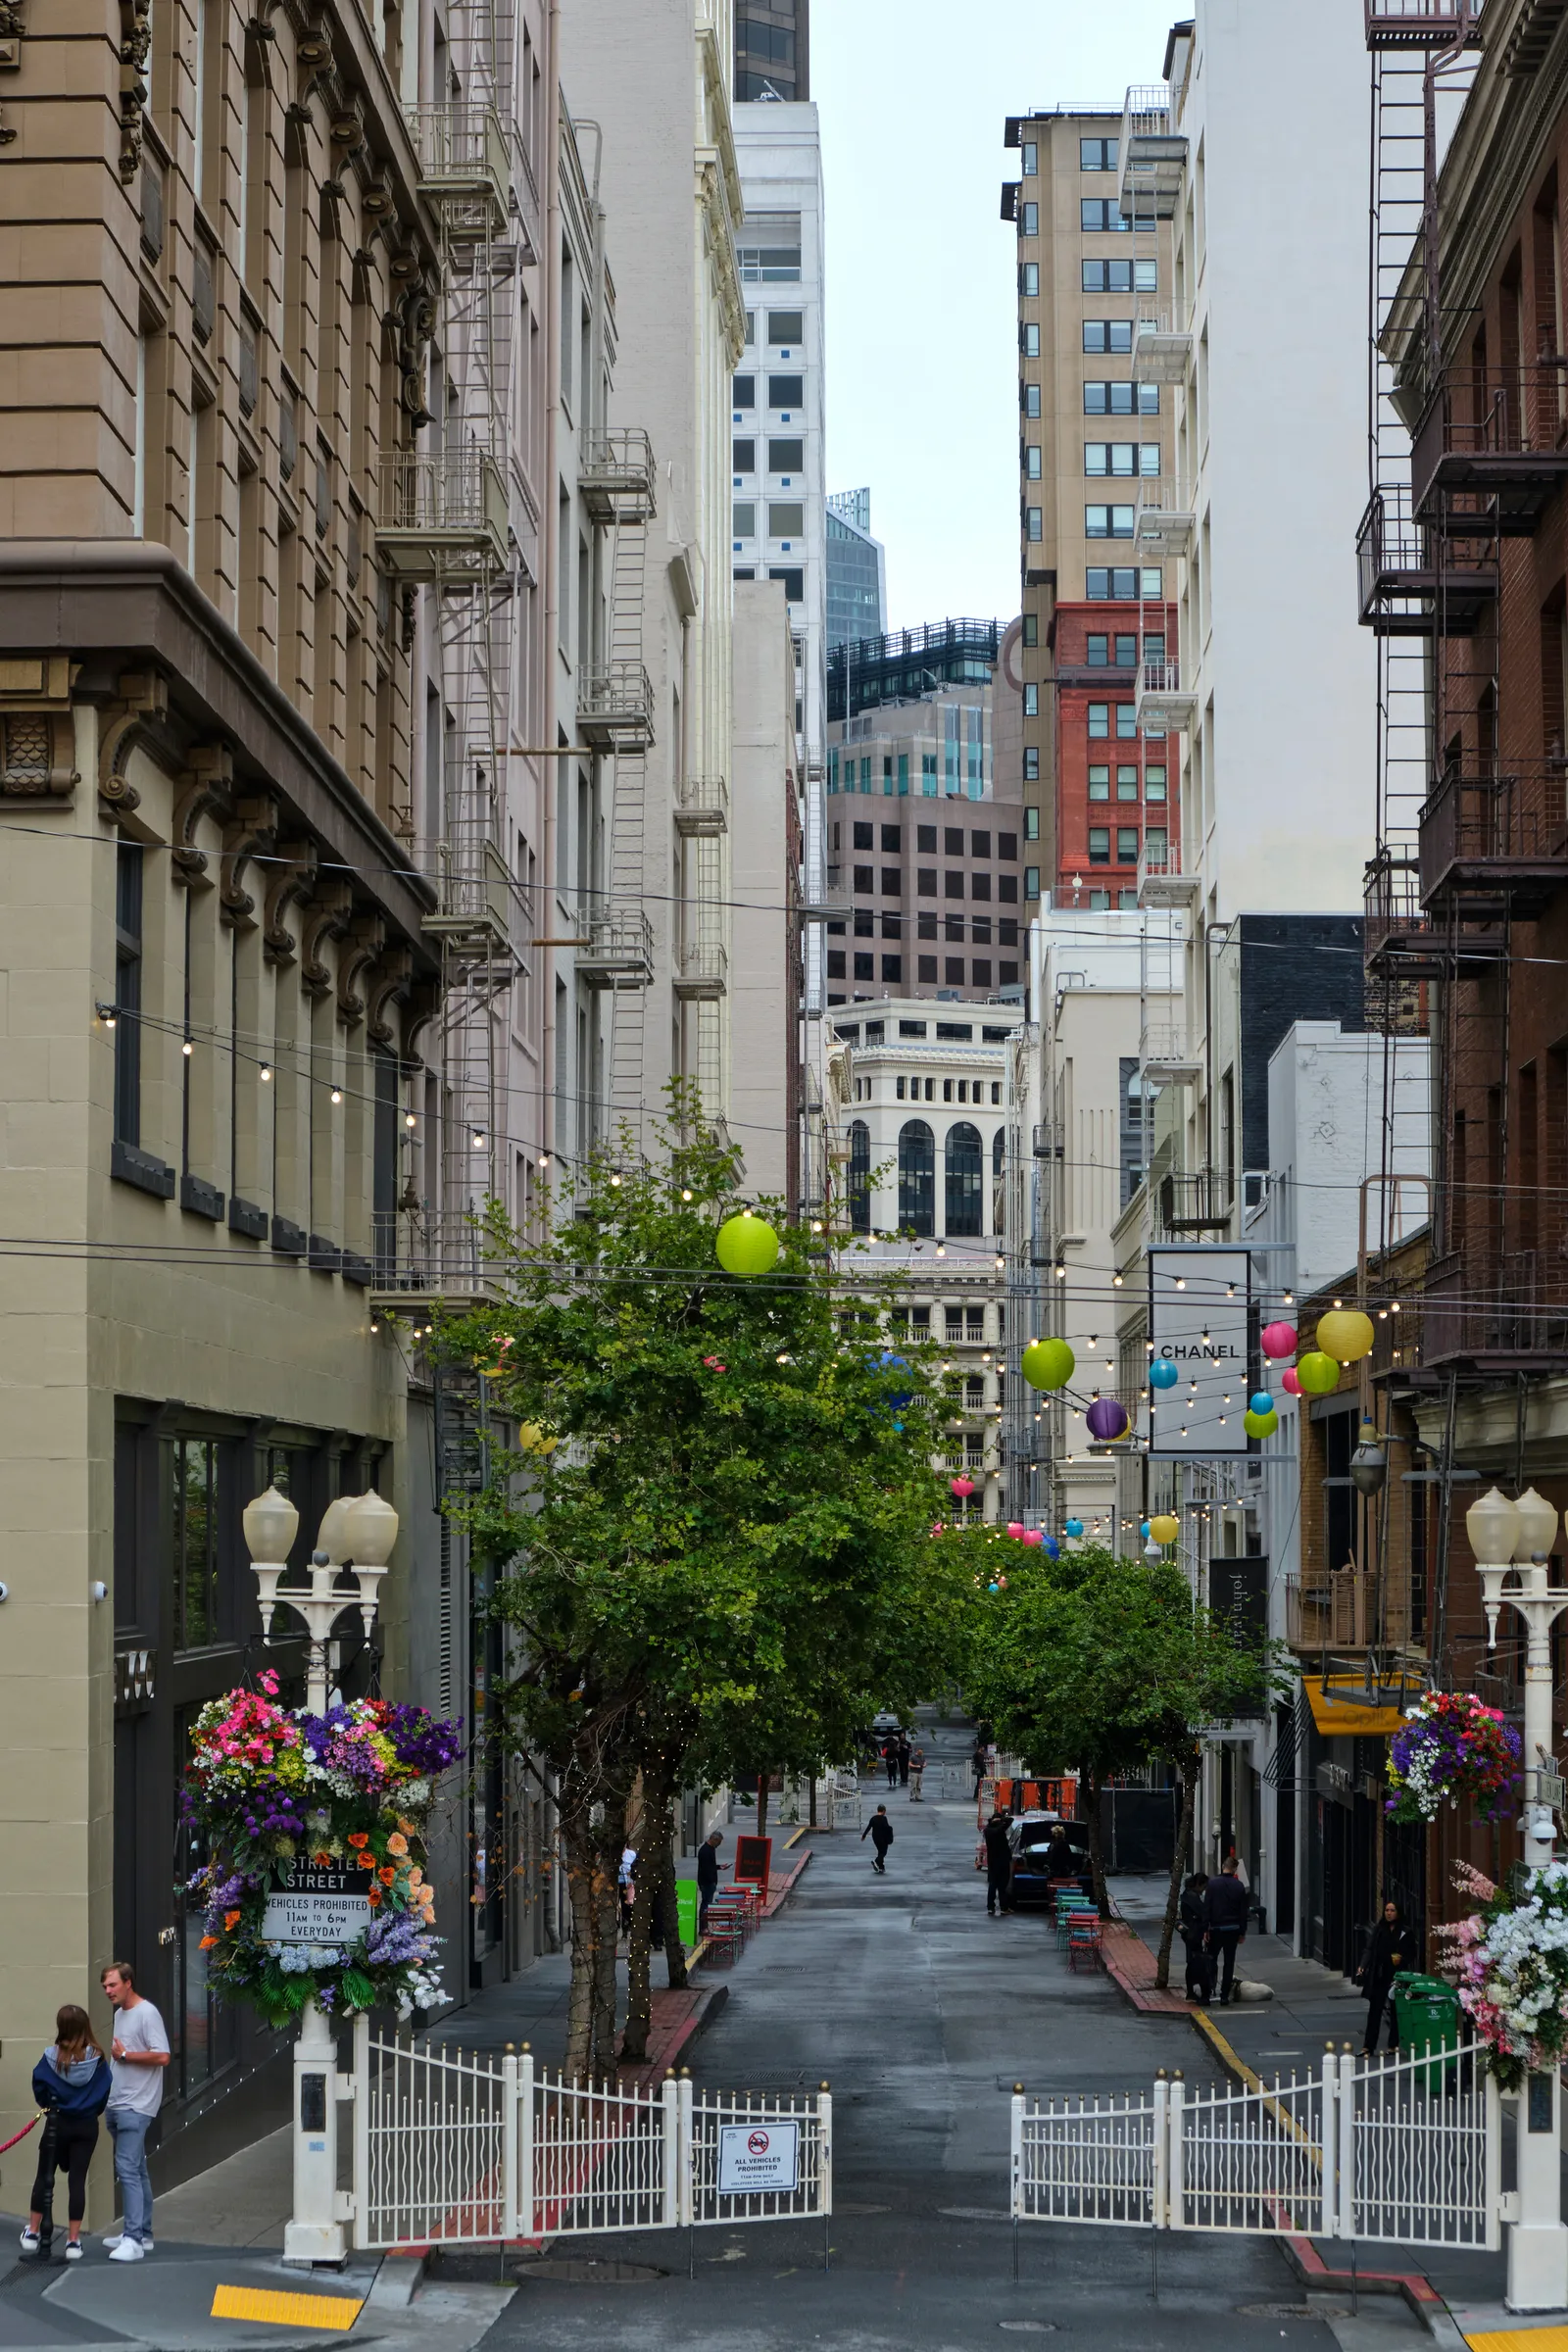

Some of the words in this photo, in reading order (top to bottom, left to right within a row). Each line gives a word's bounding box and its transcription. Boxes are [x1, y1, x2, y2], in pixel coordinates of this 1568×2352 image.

[1161, 1345, 1240, 1358] CHANEL
[1229, 1574, 1248, 1612] john
[268, 1856, 366, 1872] RSTRICTED
[287, 1874, 346, 1888] STREET
[267, 1898, 309, 1909] VEHICLES
[314, 1899, 368, 1911] PROHIBITED
[286, 1912, 308, 1922] 11AM
[327, 1913, 346, 1924] 6PM
[291, 1926, 342, 1936] EVERYDAY
